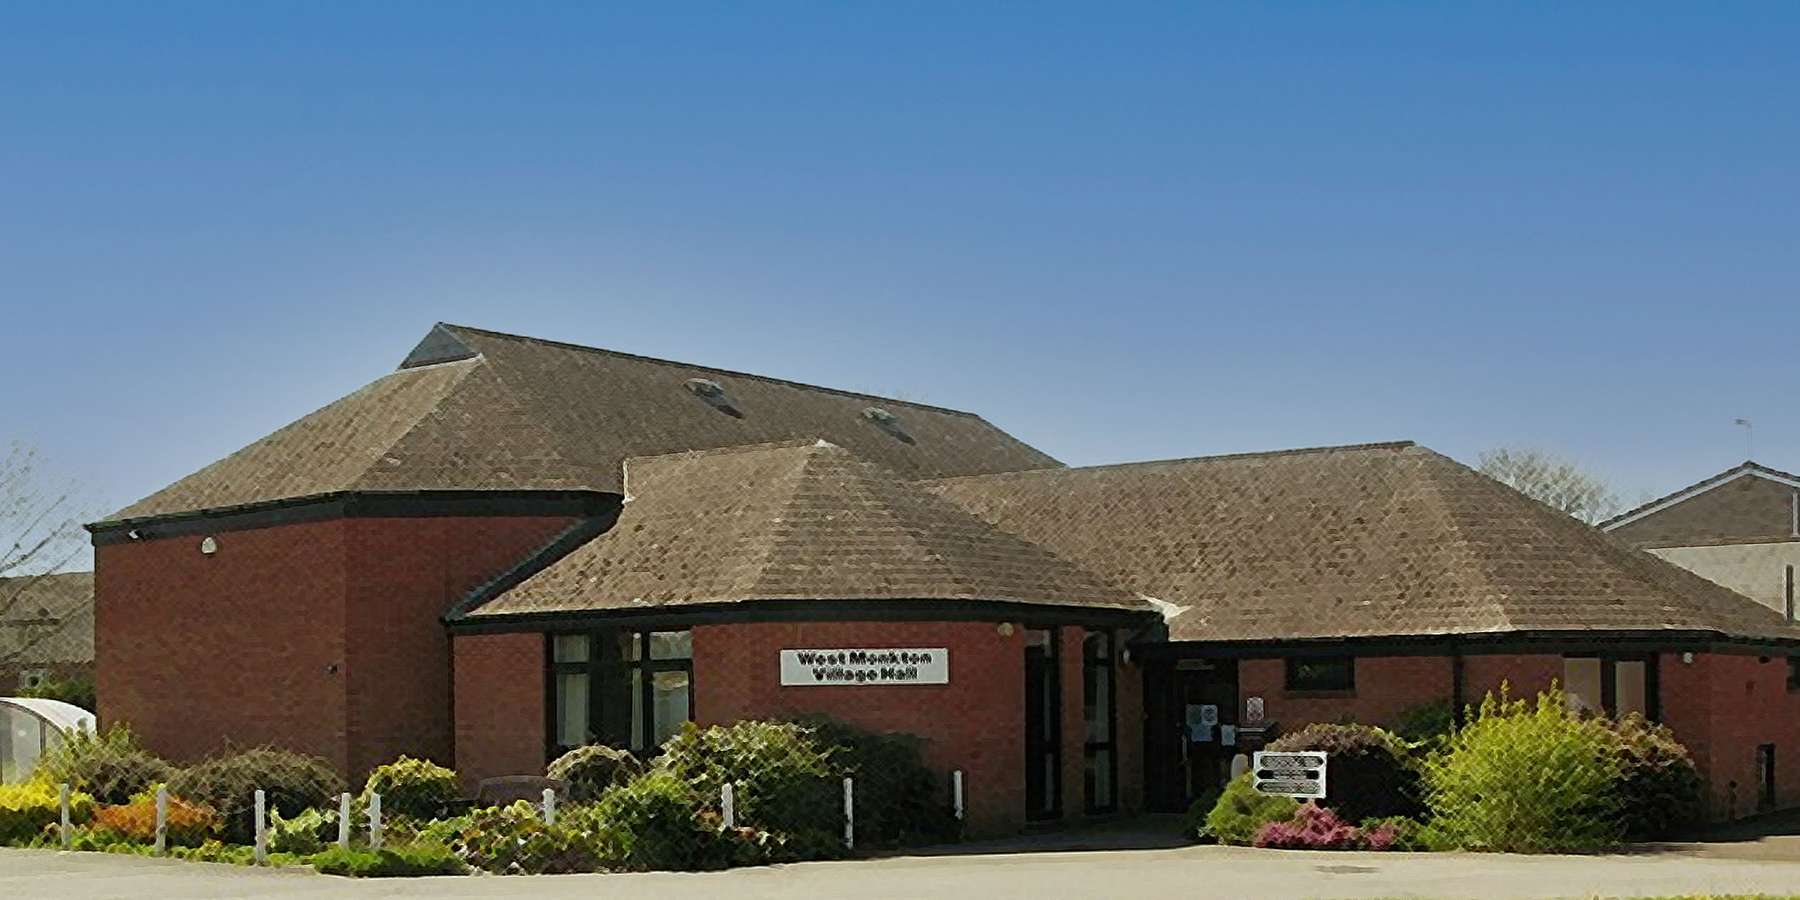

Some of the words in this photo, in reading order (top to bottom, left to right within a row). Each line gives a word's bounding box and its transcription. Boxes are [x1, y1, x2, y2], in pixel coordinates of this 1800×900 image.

[797, 652, 846, 665] West
[849, 651, 932, 665] Monkton
[812, 667, 878, 682] Village
[880, 667, 918, 680] Hall
